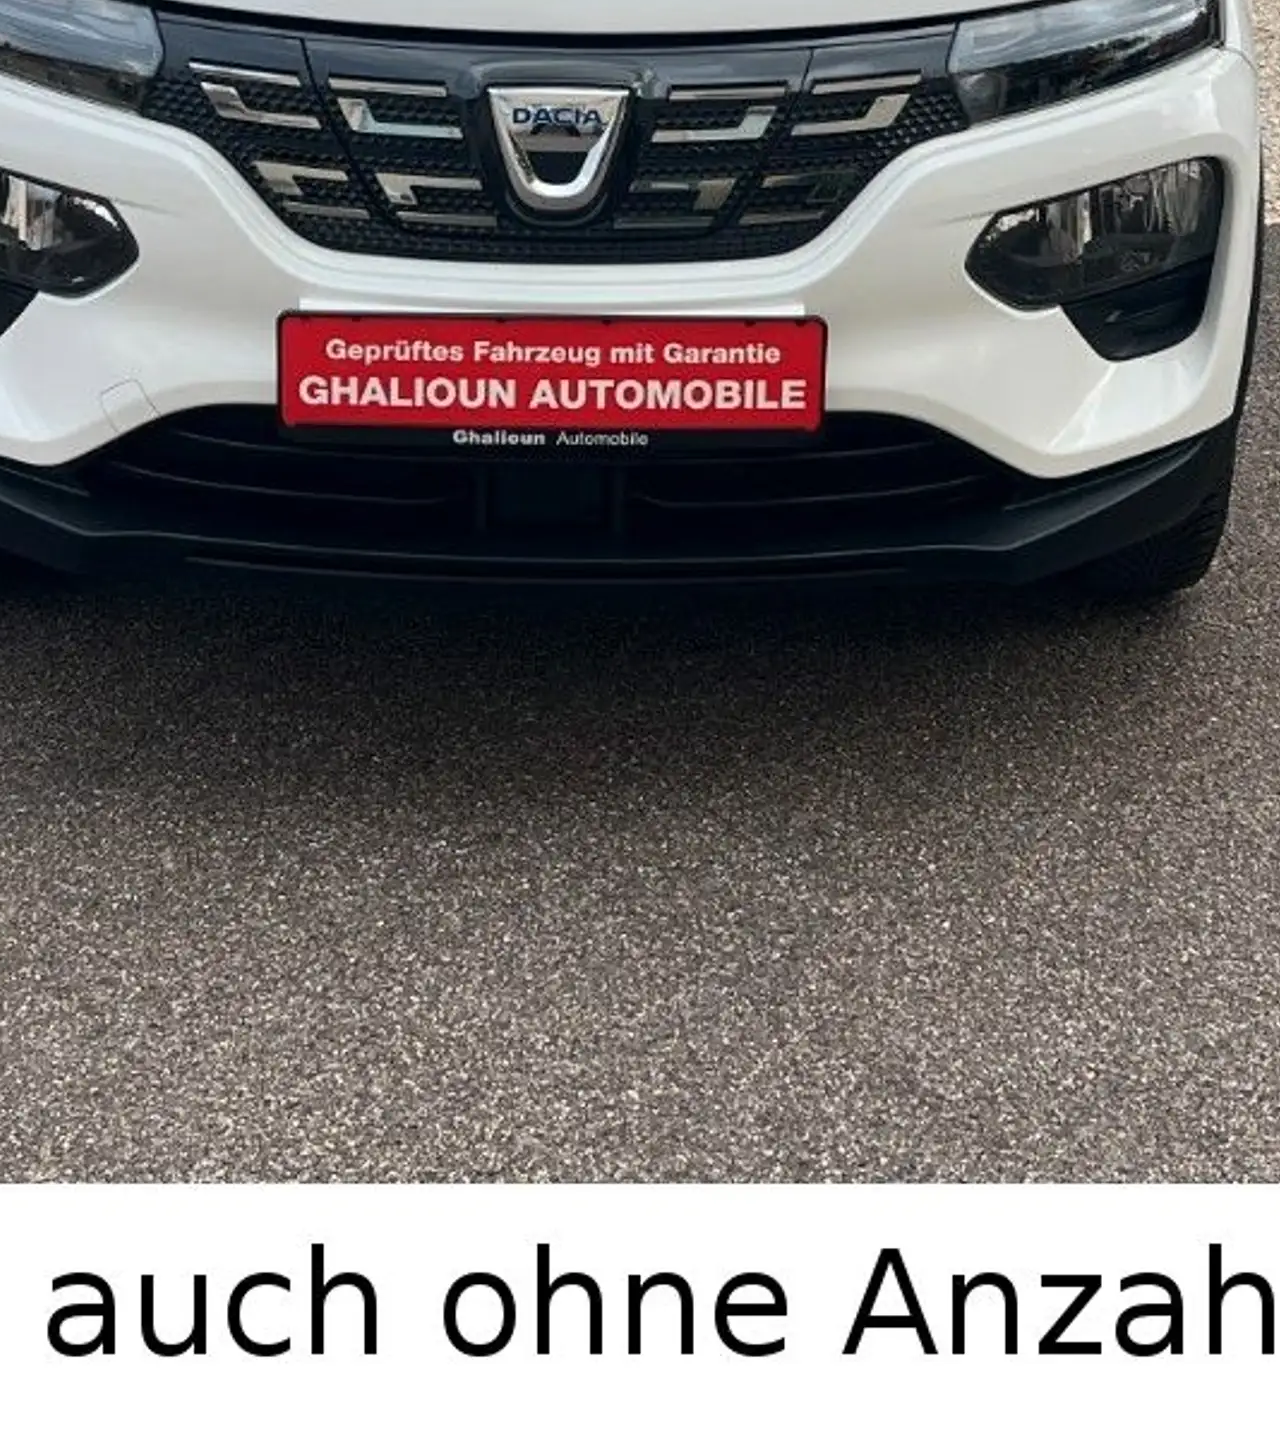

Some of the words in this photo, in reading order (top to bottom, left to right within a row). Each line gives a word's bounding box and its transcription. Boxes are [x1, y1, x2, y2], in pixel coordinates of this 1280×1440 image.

[512, 107, 602, 125] DACIA
[325, 338, 464, 366] Geprüftes
[473, 340, 601, 368] Fahrzeug
[610, 343, 655, 364] mit
[663, 343, 782, 365] Garantie
[298, 375, 517, 409] GHALIOUN
[529, 378, 807, 410] AUTOMOBILE
[452, 429, 546, 445] Ghalioun
[555, 431, 650, 446] Automobile
